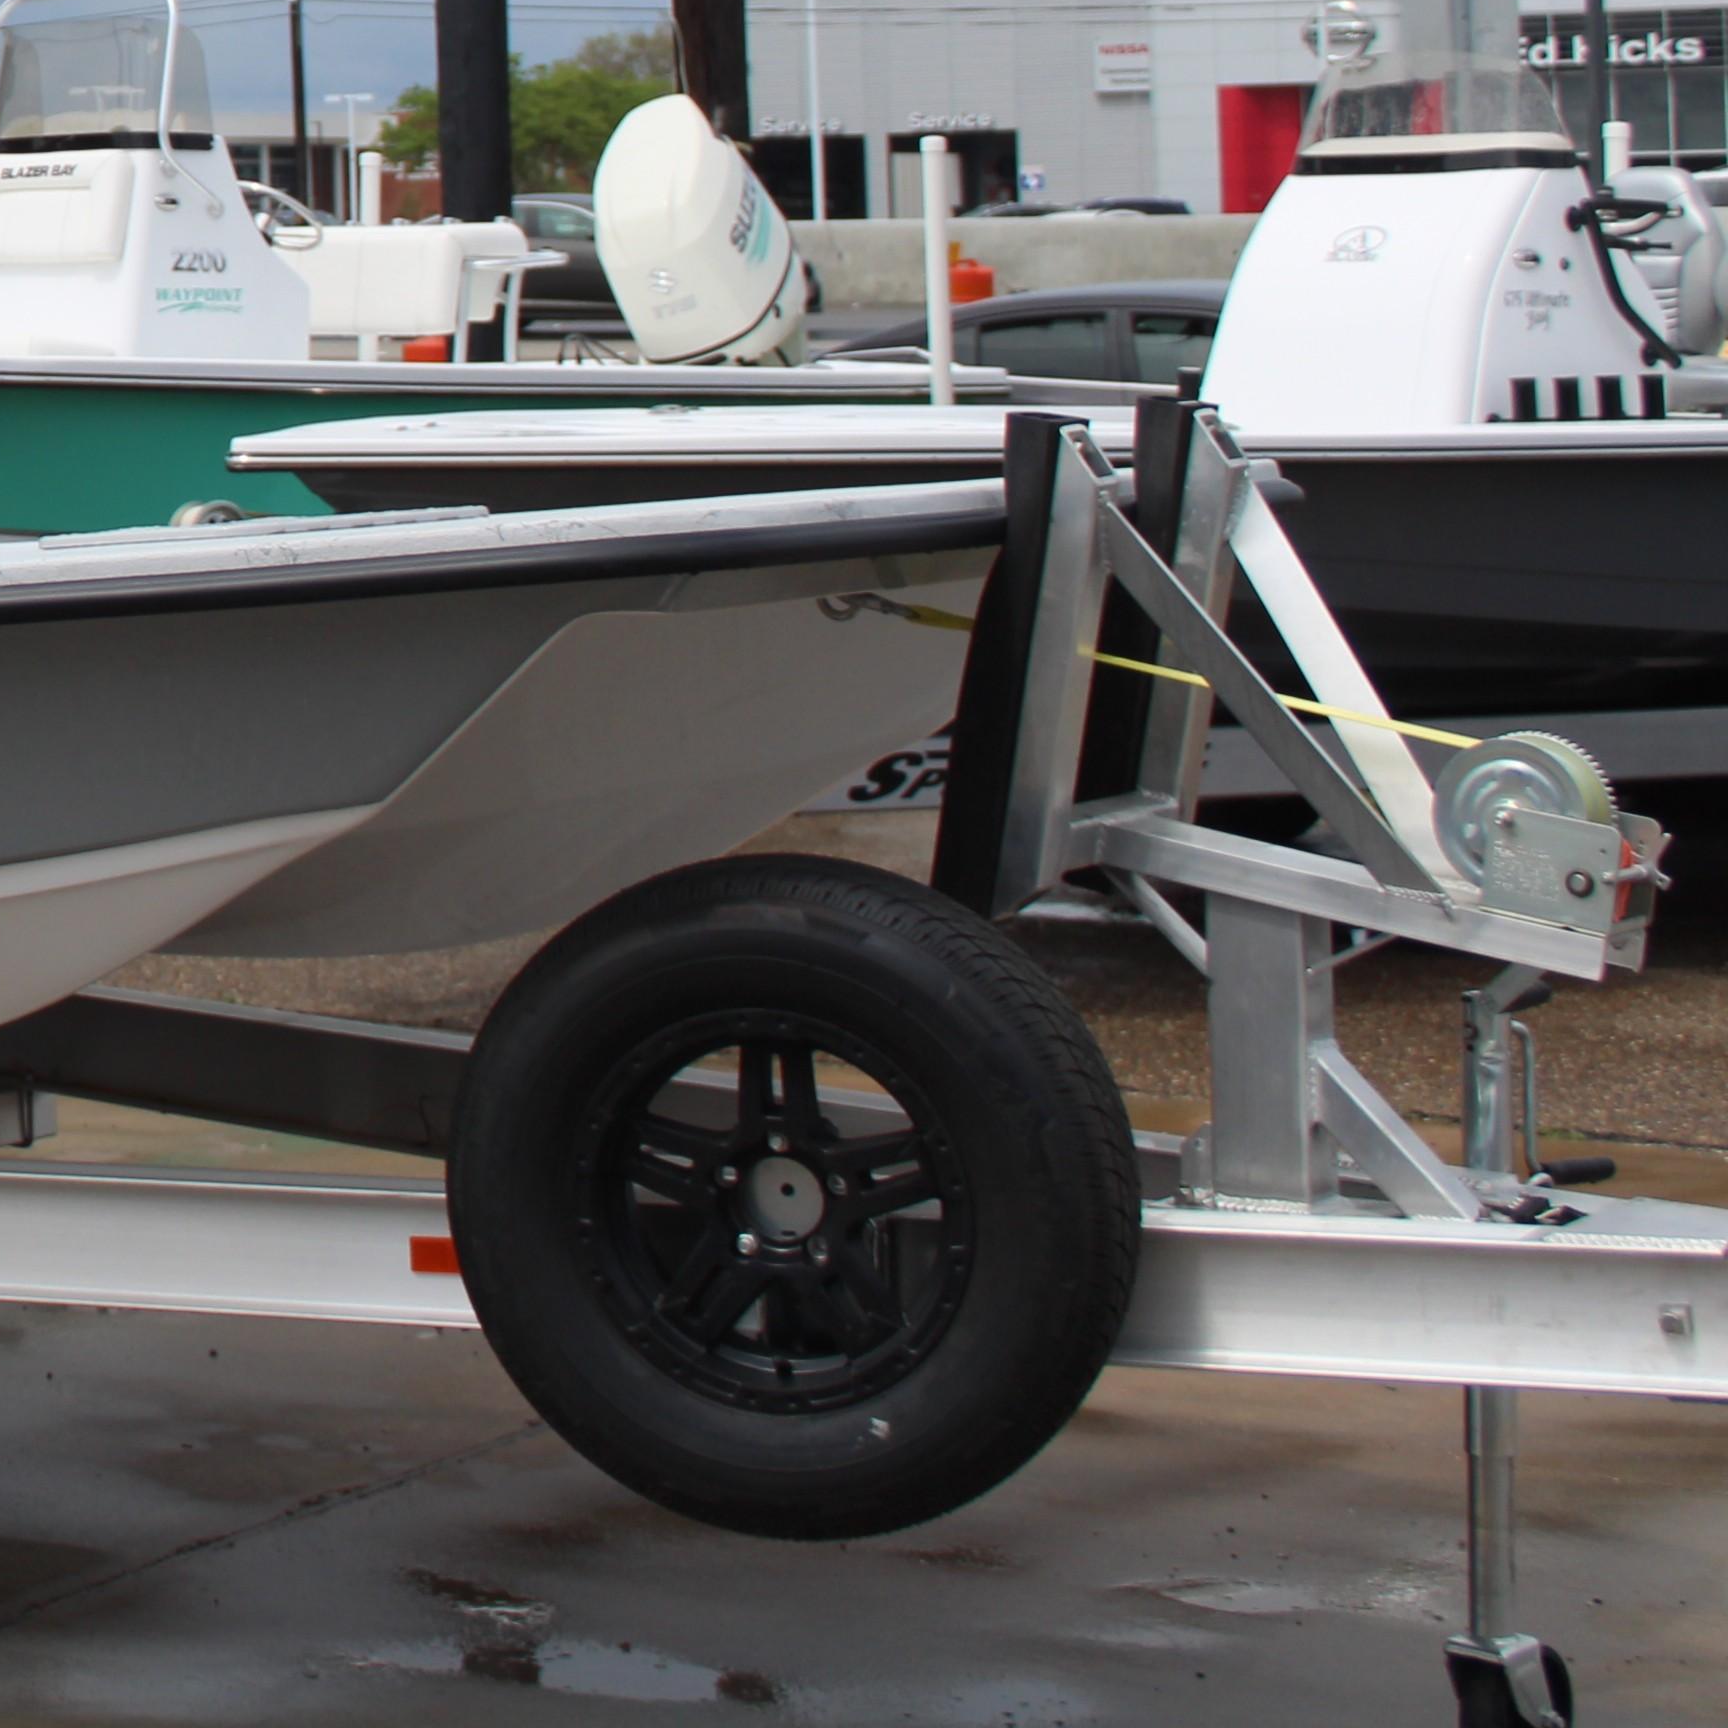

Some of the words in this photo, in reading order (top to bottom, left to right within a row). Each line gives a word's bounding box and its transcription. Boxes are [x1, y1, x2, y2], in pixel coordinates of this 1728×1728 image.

[760, 117, 842, 134] Servce
[908, 112, 993, 129] Service
[0, 165, 49, 180] BLAZER
[51, 163, 78, 177] BAY
[171, 249, 227, 273] 2200
[155, 287, 245, 301] WAYPOINT
